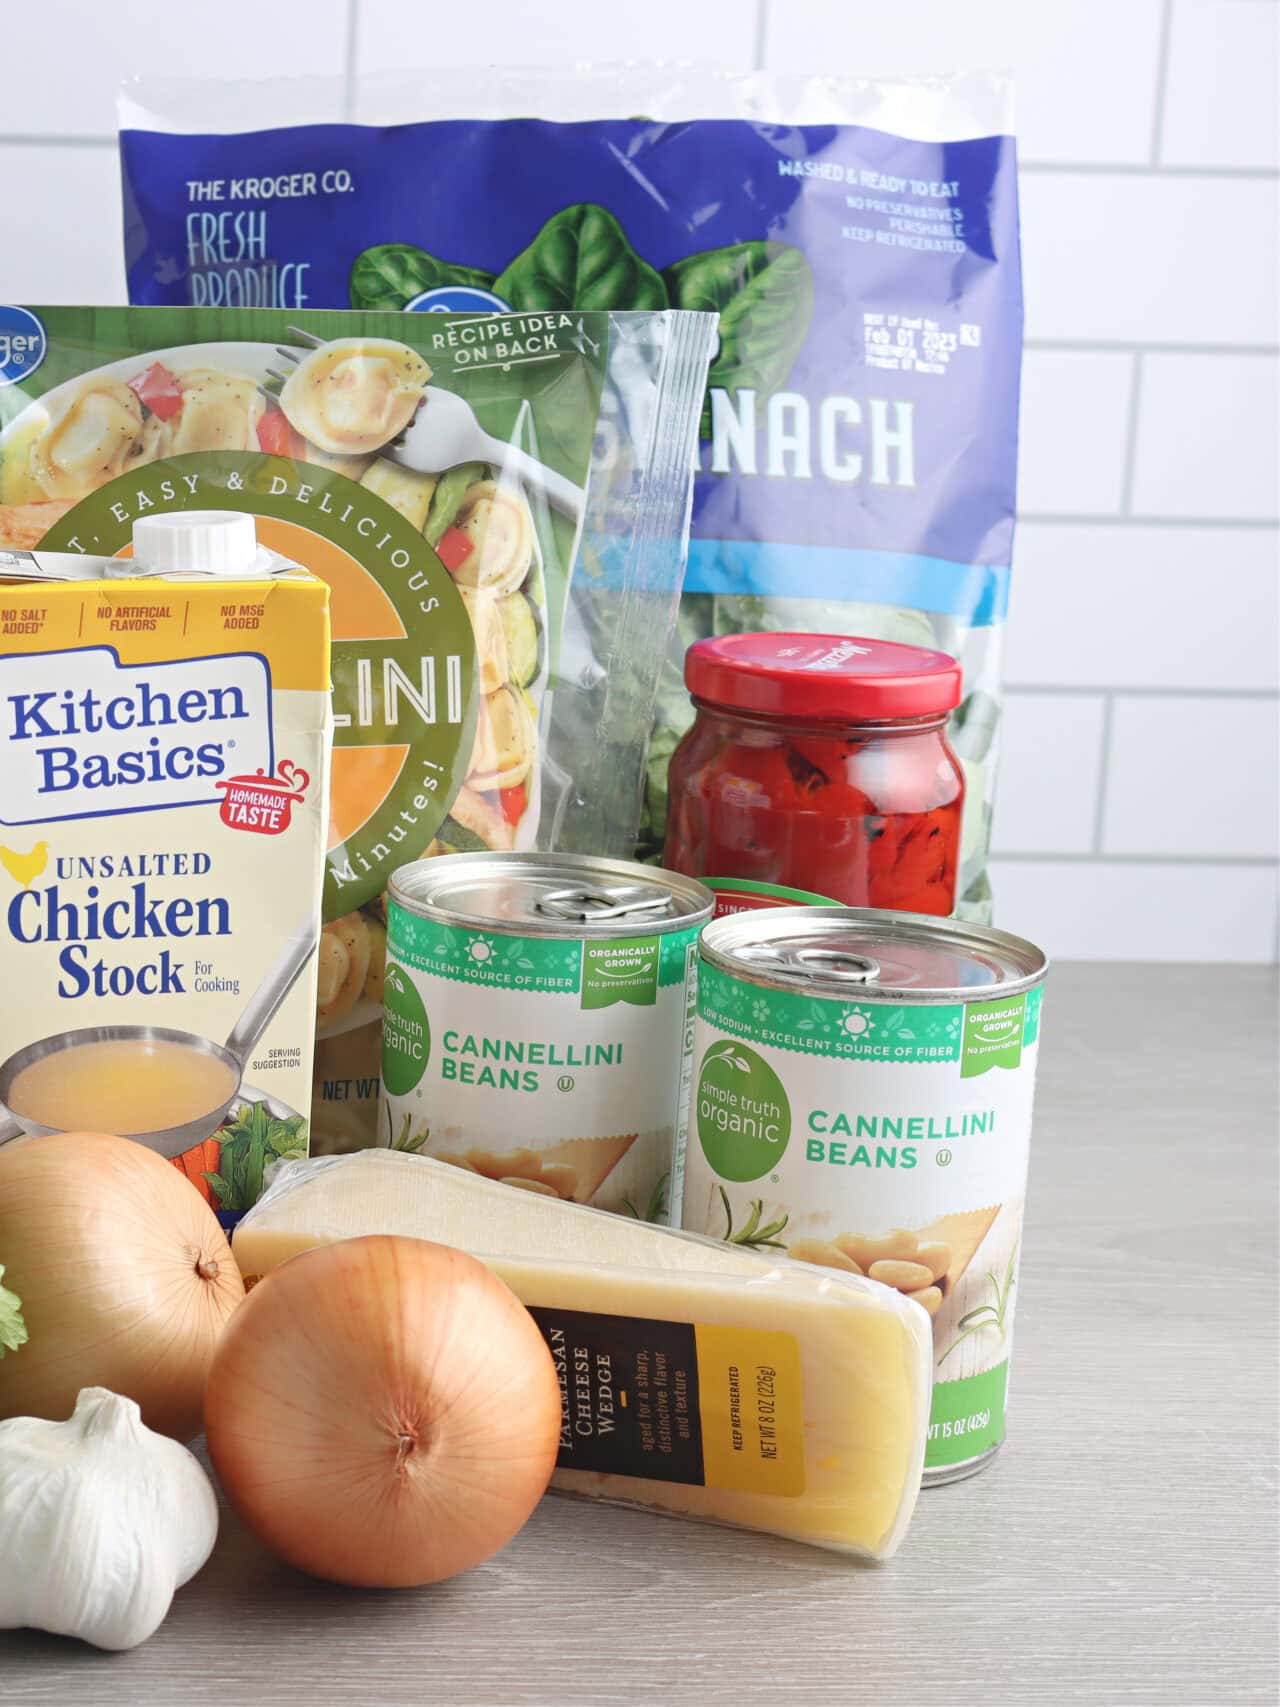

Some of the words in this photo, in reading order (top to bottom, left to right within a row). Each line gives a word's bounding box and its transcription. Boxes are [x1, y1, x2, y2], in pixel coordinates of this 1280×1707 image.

[187, 180, 224, 201] THE
[230, 172, 317, 200] KROGER
[322, 169, 355, 193] CO.
[778, 159, 844, 182] WASHED
[846, 169, 858, 185] &
[860, 171, 907, 193] READY
[910, 180, 928, 196] TO
[928, 182, 959, 198] EAT
[846, 195, 865, 210] NO
[866, 198, 964, 221] PRESERVATIVES
[186, 210, 267, 267] FRESH
[842, 226, 875, 242] KEEP
[876, 229, 966, 254] REFRIGERATED
[431, 321, 514, 350] RECIPE
[519, 314, 573, 335] IDEA
[454, 346, 488, 365] ON
[495, 333, 558, 359] BACK
[109, 473, 201, 525] EASY
[227, 471, 244, 491] &
[269, 475, 441, 614] DELICIOUS
[1, 609, 17, 622] NO
[20, 608, 48, 622] SALT
[96, 606, 112, 619] NO
[115, 606, 172, 620] ARTIFICIAL
[220, 605, 237, 617] NO
[239, 604, 265, 617] MSG
[223, 618, 260, 630] ADDED
[109, 619, 158, 632] FLAVORS
[7, 682, 250, 741] Kitchen
[36, 736, 225, 794] Basics
[229, 788, 288, 810] HOMEMADE
[228, 802, 283, 830] TASTE
[328, 759, 445, 890] Minutes!
[55, 852, 212, 880] UNSALTED
[7, 882, 233, 944] Chicken
[588, 945, 656, 958] ORGANICALLY
[605, 957, 642, 968] GROWN
[57, 944, 186, 999] Stock
[194, 960, 214, 975] For
[410, 952, 463, 975] EXCELLENT
[463, 967, 512, 984] SOURCE
[514, 975, 532, 986] OF
[535, 976, 573, 988] FIBER
[194, 977, 240, 995] Cooking
[587, 979, 600, 989] No
[398, 1013, 423, 1038] truth
[969, 1006, 1023, 1024] ORGANICALLY
[983, 1020, 1013, 1032] GROWN
[384, 1022, 423, 1060] rganic
[702, 1007, 717, 1022] LOW
[718, 1014, 751, 1034] SODIUM
[761, 1028, 831, 1051] EXCELLENT
[835, 1042, 890, 1057] SOURCE
[894, 1045, 913, 1057] OF
[917, 1045, 954, 1057] FIBER
[268, 1047, 301, 1058] SERVING
[442, 1030, 624, 1067] CANNELLINI
[252, 1059, 301, 1070] SUGGESTION
[441, 1057, 540, 1093] BEANS
[322, 1079, 353, 1100] NET
[702, 1080, 738, 1108] simple
[740, 1095, 781, 1120] truth
[700, 1100, 780, 1144] organic
[807, 1110, 995, 1140] CANNELLINI
[805, 1139, 918, 1169] BEANS
[653, 1351, 668, 1387] flavor
[756, 1366, 776, 1398] (226g)
[574, 1347, 593, 1436] CHEESE
[597, 1354, 617, 1436] WEDGE
[674, 1369, 688, 1413] texture
[728, 1366, 741, 1429] REFRIGERATED
[758, 1399, 775, 1414] OZ
[759, 1414, 775, 1423] 8
[657, 1391, 672, 1453] distinctive
[675, 1415, 690, 1440] and
[759, 1423, 776, 1438] WT
[942, 1421, 952, 1438] 15
[954, 1417, 966, 1436] OZ
[731, 1429, 744, 1451] KEEP
[761, 1438, 777, 1460] NET
